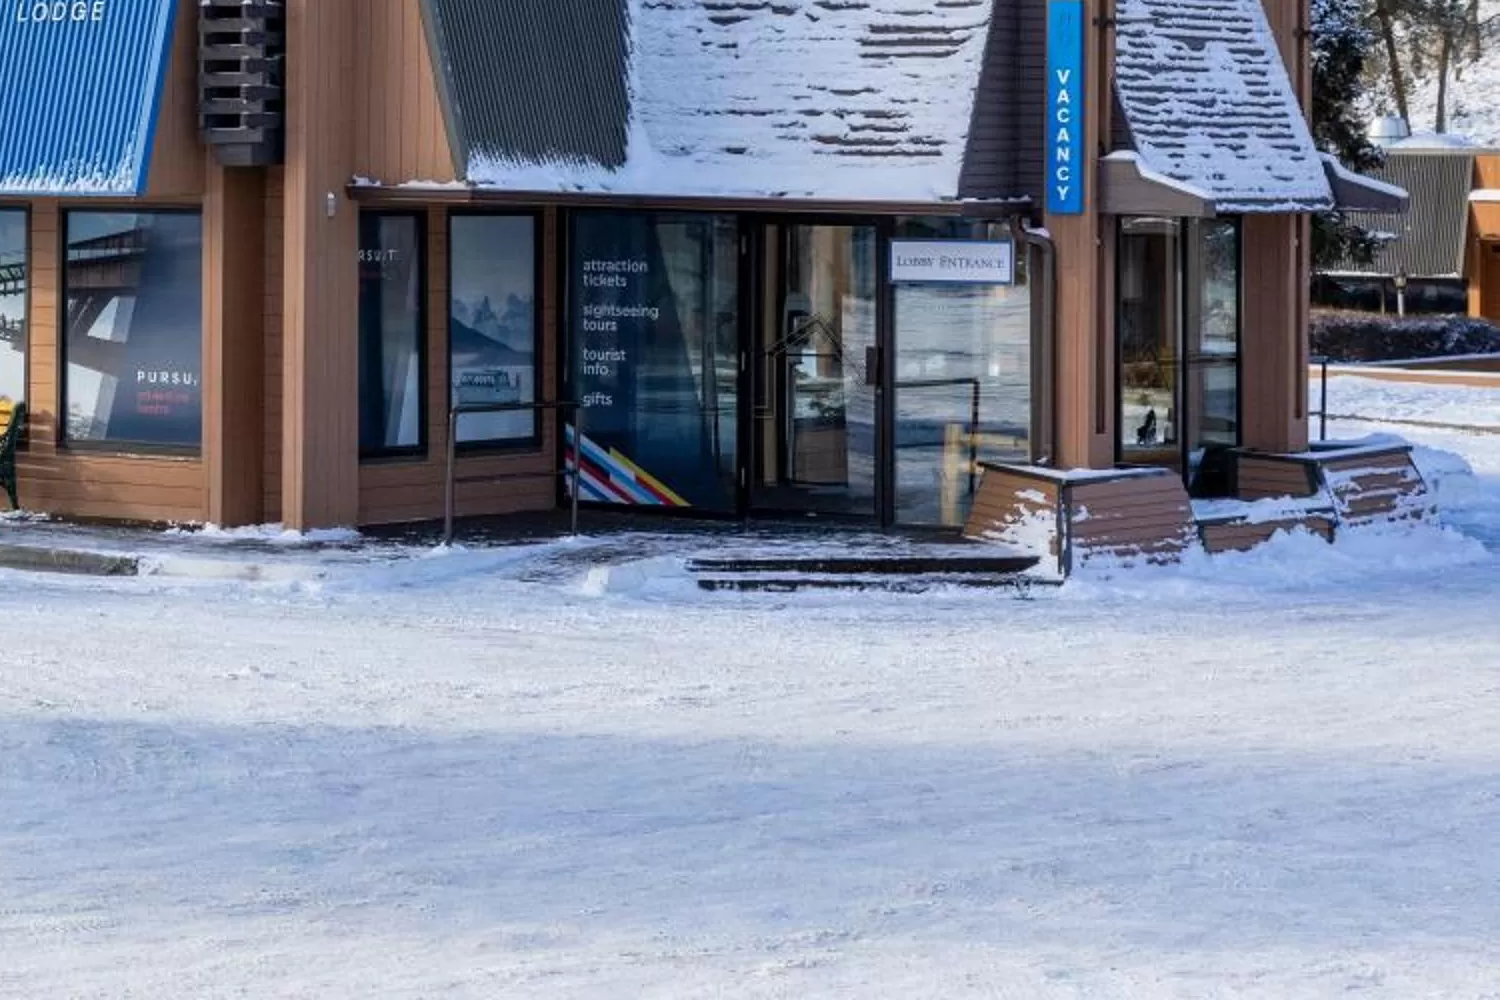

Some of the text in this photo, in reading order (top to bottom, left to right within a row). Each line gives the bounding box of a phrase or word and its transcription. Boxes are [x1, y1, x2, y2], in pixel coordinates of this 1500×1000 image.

[17, 1, 105, 22] LODGE
[1056, 69, 1071, 201] VACANCY
[583, 259, 648, 273] attraction
[939, 256, 1005, 269] ENTRANCE
[583, 273, 627, 287] tickets
[583, 304, 659, 320] sightseeing
[583, 319, 618, 331] tours
[583, 347, 626, 361] tourist
[583, 362, 610, 376] info
[583, 392, 613, 408] gifts
